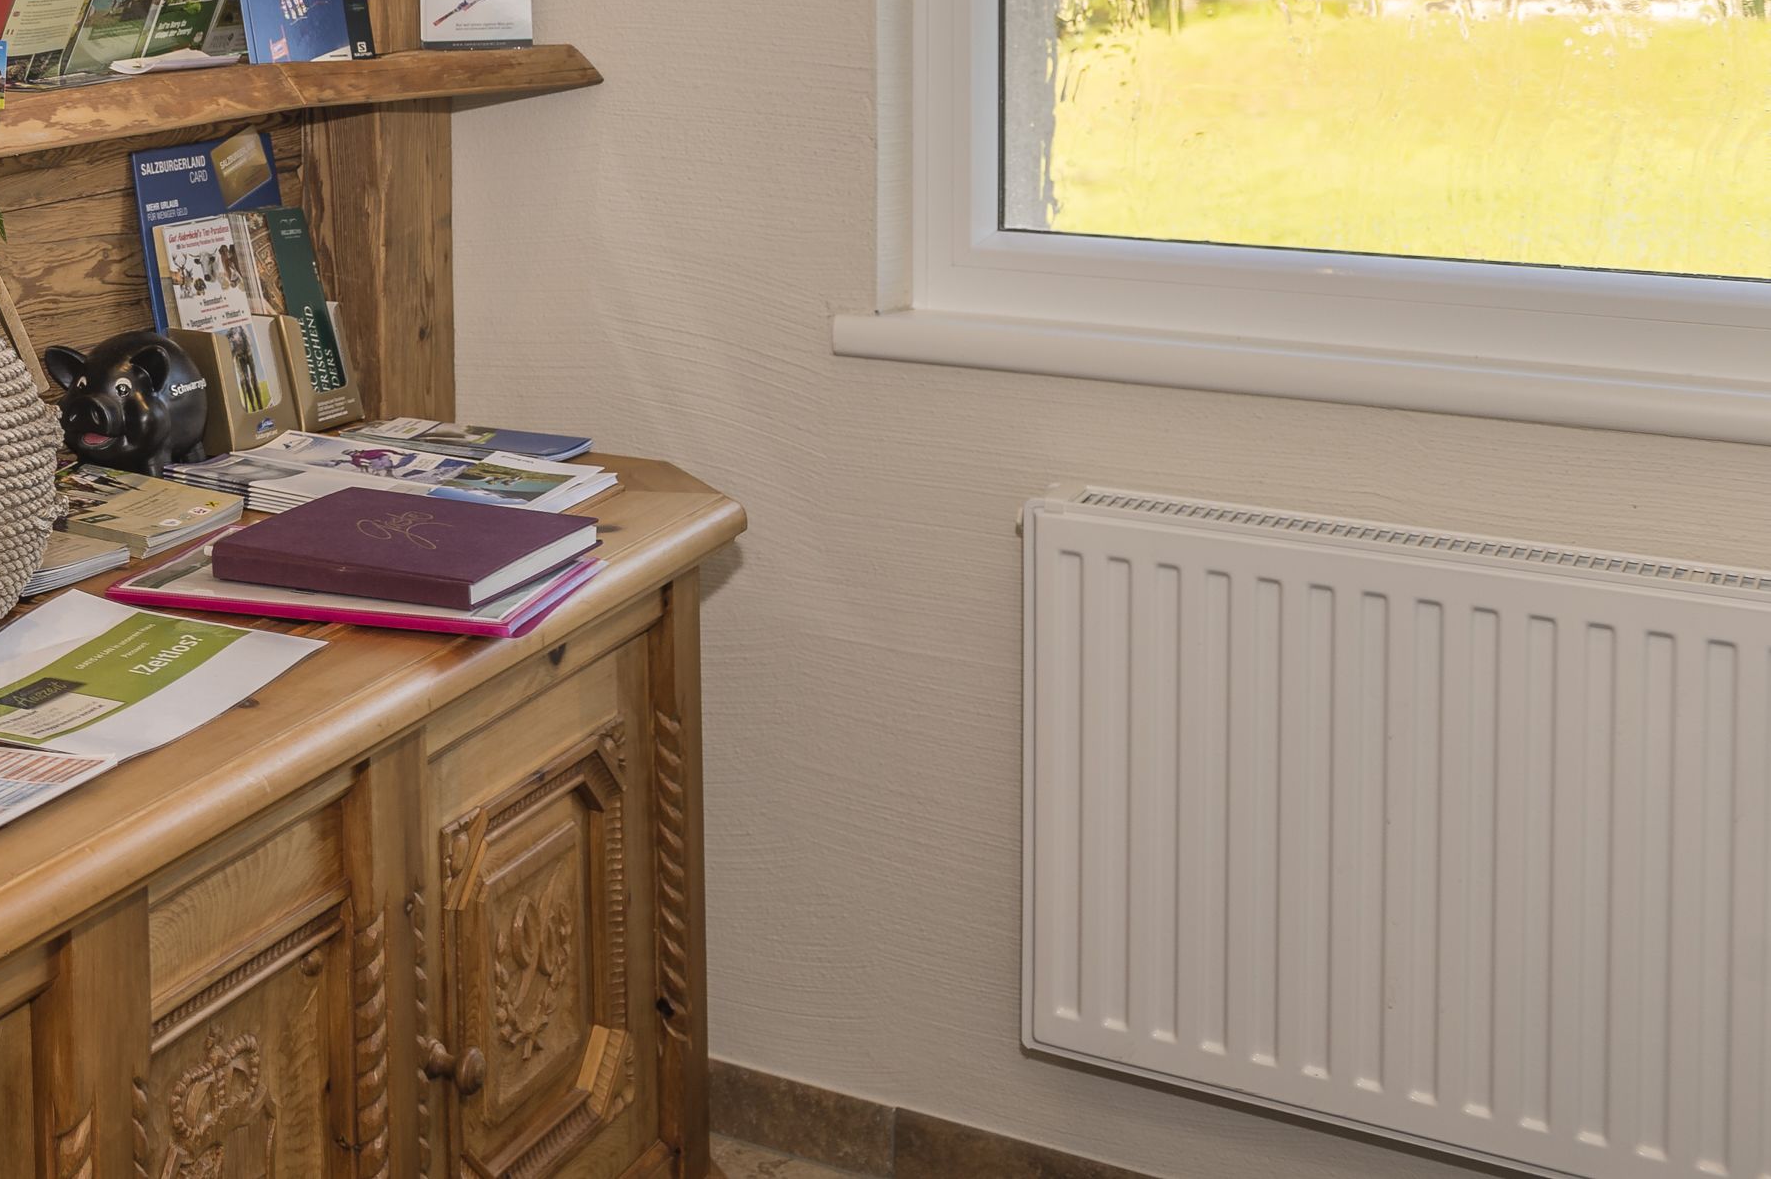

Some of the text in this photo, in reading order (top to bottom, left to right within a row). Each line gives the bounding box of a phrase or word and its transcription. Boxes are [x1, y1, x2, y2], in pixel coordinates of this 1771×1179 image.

[141, 155, 206, 177] SALZBURGERLAND
[189, 170, 208, 184] CARD
[128, 633, 204, 676] !Zeitlos?
[14, 682, 68, 708] Auszeit
